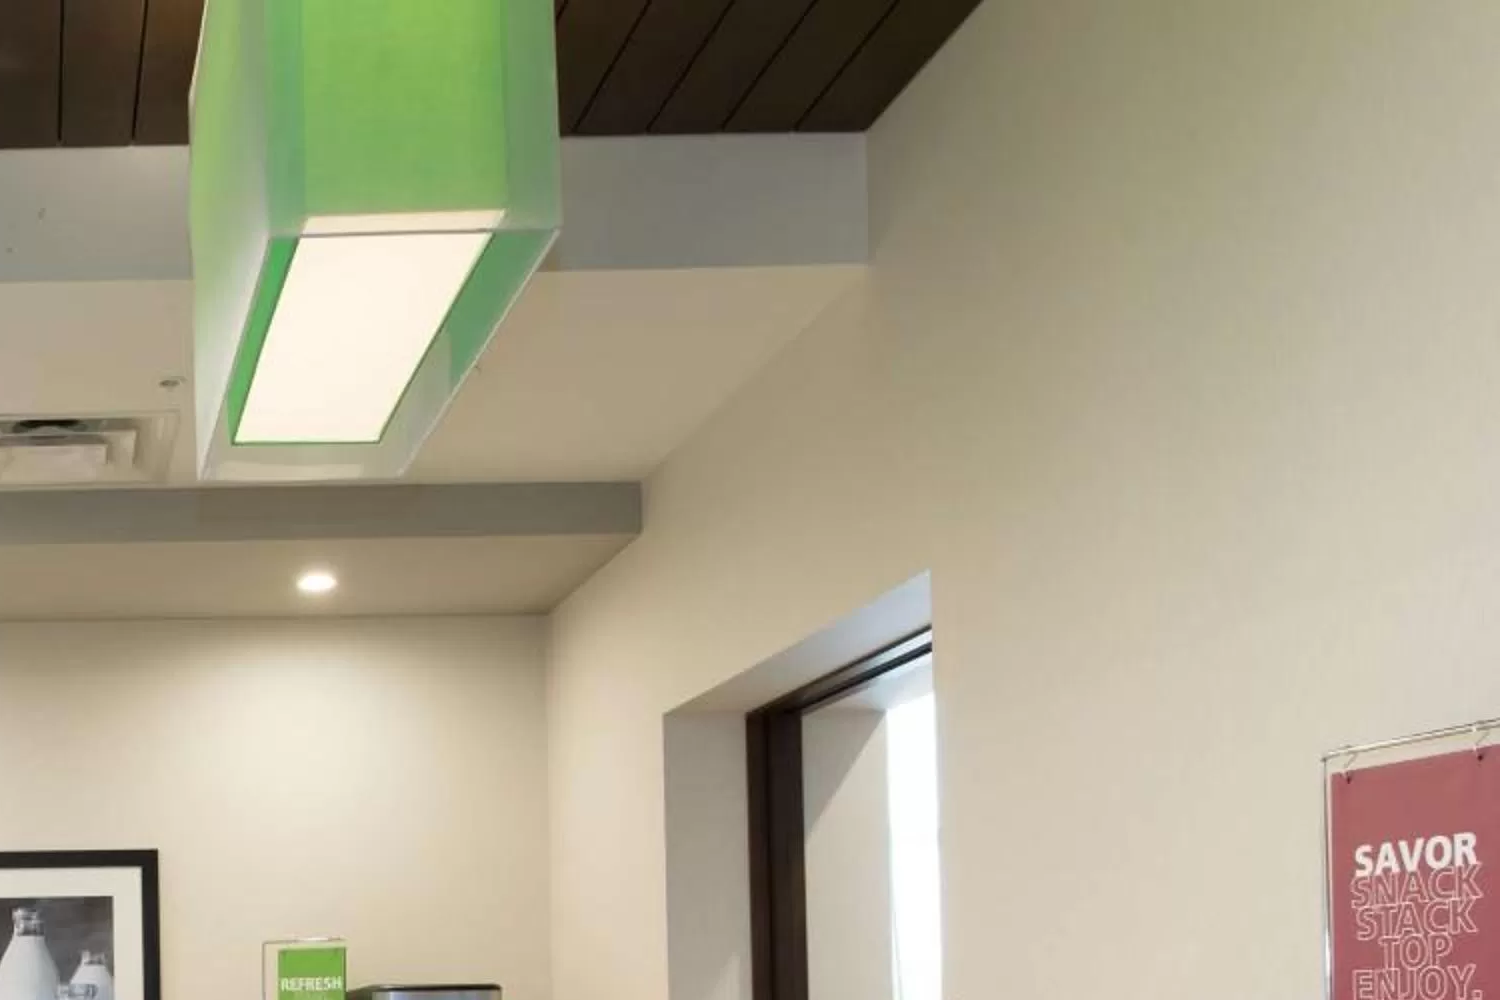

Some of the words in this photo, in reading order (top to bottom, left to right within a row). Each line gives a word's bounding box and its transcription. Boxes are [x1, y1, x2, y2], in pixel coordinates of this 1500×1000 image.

[1354, 832, 1477, 877] SAVOR
[1351, 861, 1483, 908] SNACK
[1356, 898, 1478, 940] STACK
[1379, 933, 1453, 969] TOP
[281, 976, 341, 991] REFRESH
